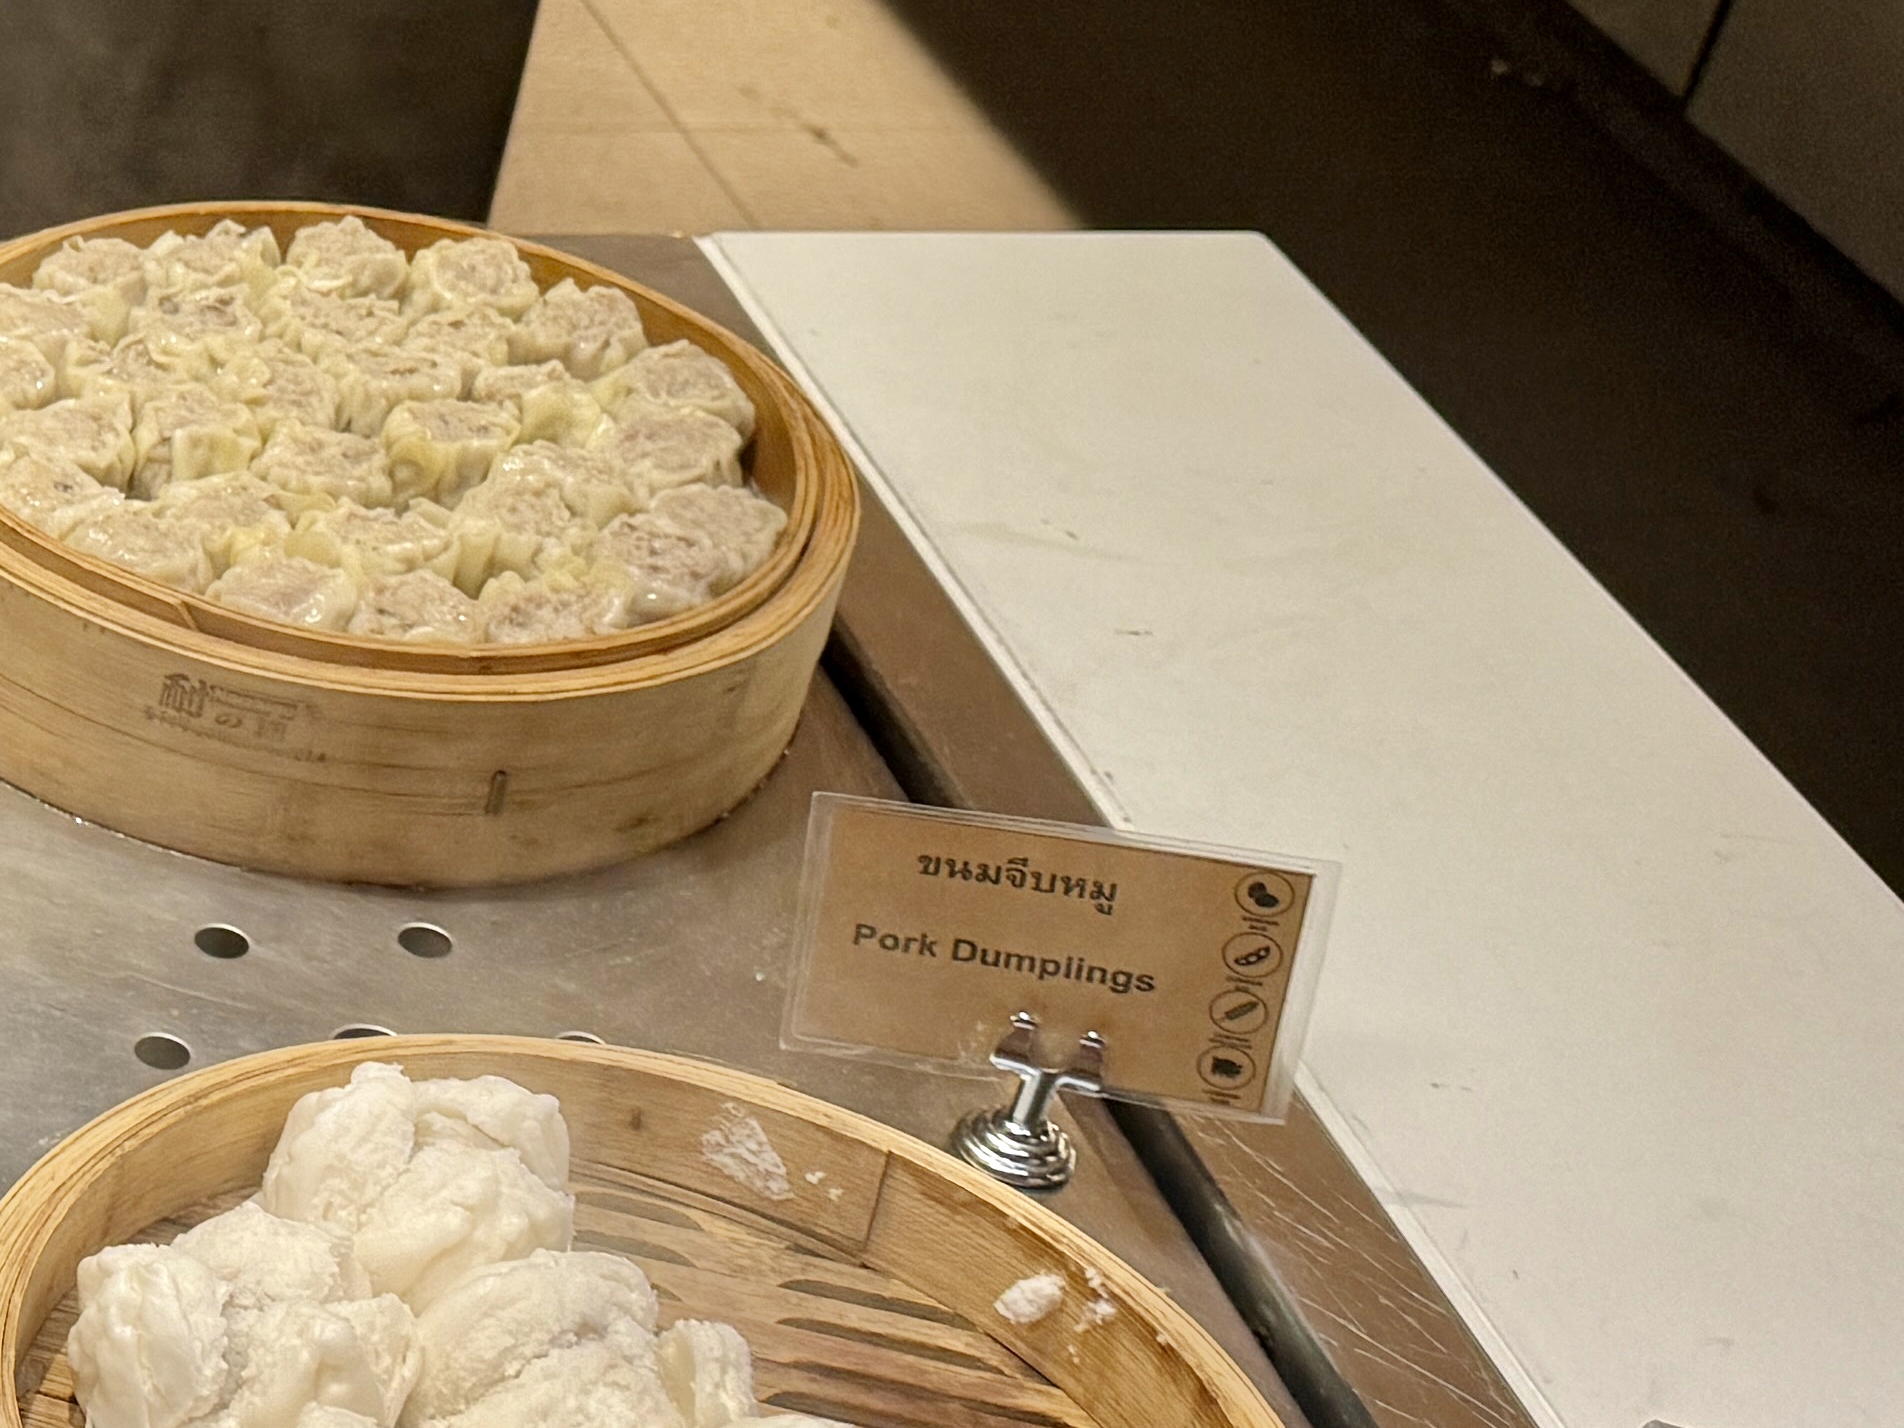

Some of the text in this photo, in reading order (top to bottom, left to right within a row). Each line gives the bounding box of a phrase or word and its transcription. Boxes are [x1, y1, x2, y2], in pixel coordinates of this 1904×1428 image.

[917, 853, 1118, 916] ขนมจีบหมู
[852, 922, 1156, 994] Pork Dumplings
